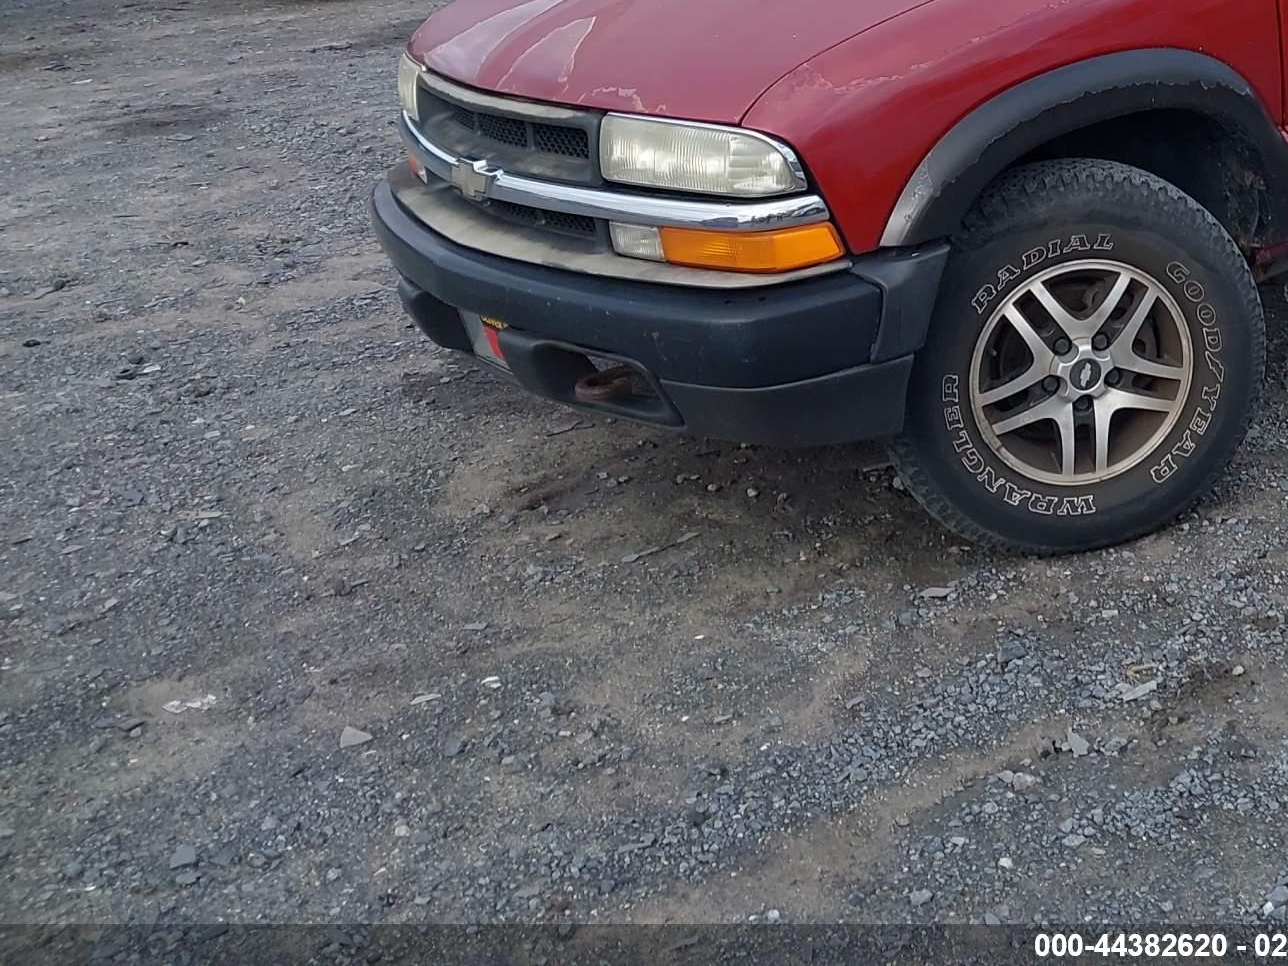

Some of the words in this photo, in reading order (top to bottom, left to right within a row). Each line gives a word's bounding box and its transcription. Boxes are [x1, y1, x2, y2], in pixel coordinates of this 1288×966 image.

[972, 233, 1116, 315] RADIAL
[1151, 260, 1226, 484] GOODYEAR
[942, 374, 1097, 516] WRANGLER
